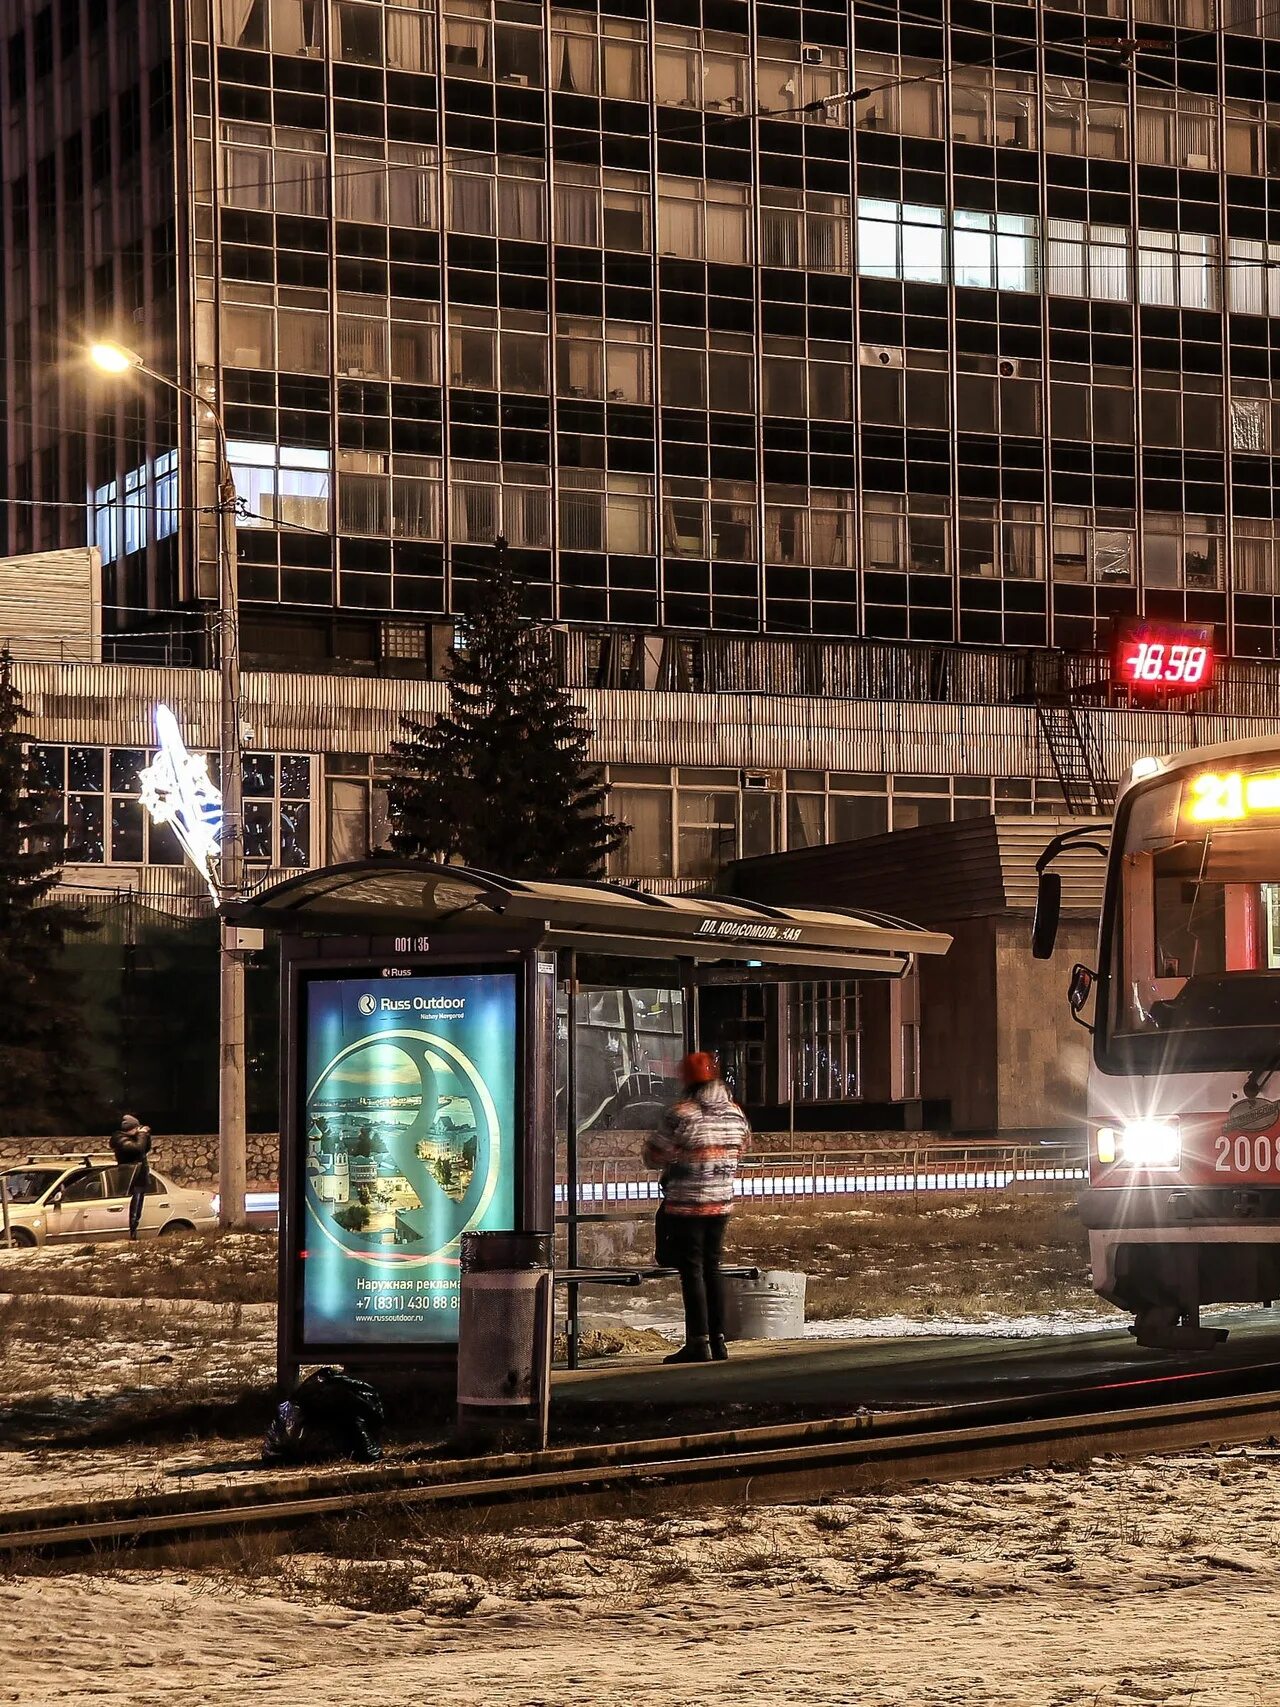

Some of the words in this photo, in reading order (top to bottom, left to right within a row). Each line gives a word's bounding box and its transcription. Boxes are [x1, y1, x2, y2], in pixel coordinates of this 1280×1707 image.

[1191, 771, 1246, 822] 21
[699, 919, 717, 933] ПЛ.
[717, 921, 803, 941] КОМСОМОЛЬКАЯ
[391, 968, 412, 977] Russ
[380, 998, 411, 1011] Russ
[413, 996, 466, 1010] Outdoor
[356, 1278, 413, 1292] Наружная
[356, 1296, 371, 1309] +7
[374, 1295, 404, 1310] (831)
[407, 1296, 430, 1309] 430
[432, 1296, 448, 1309] 88
[355, 1313, 424, 1322] www.russoutdoor.ru
